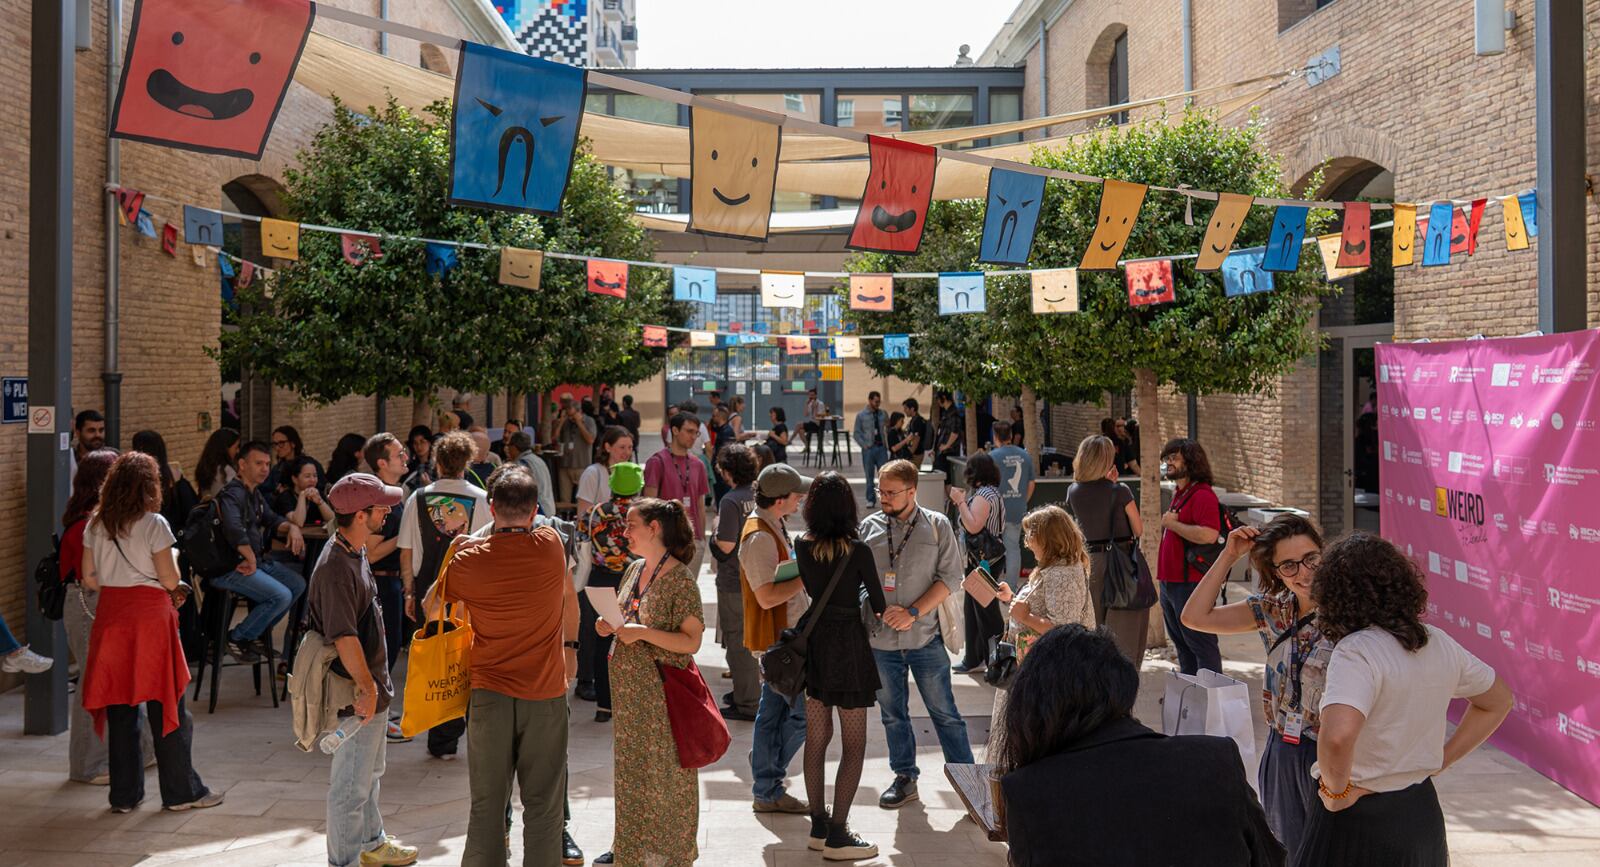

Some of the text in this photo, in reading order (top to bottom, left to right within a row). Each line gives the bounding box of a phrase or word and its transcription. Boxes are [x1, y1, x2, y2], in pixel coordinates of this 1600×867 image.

[1447, 488, 1485, 526] WEIRD
[448, 662, 460, 674] MY
[428, 669, 467, 688] WEAPON
